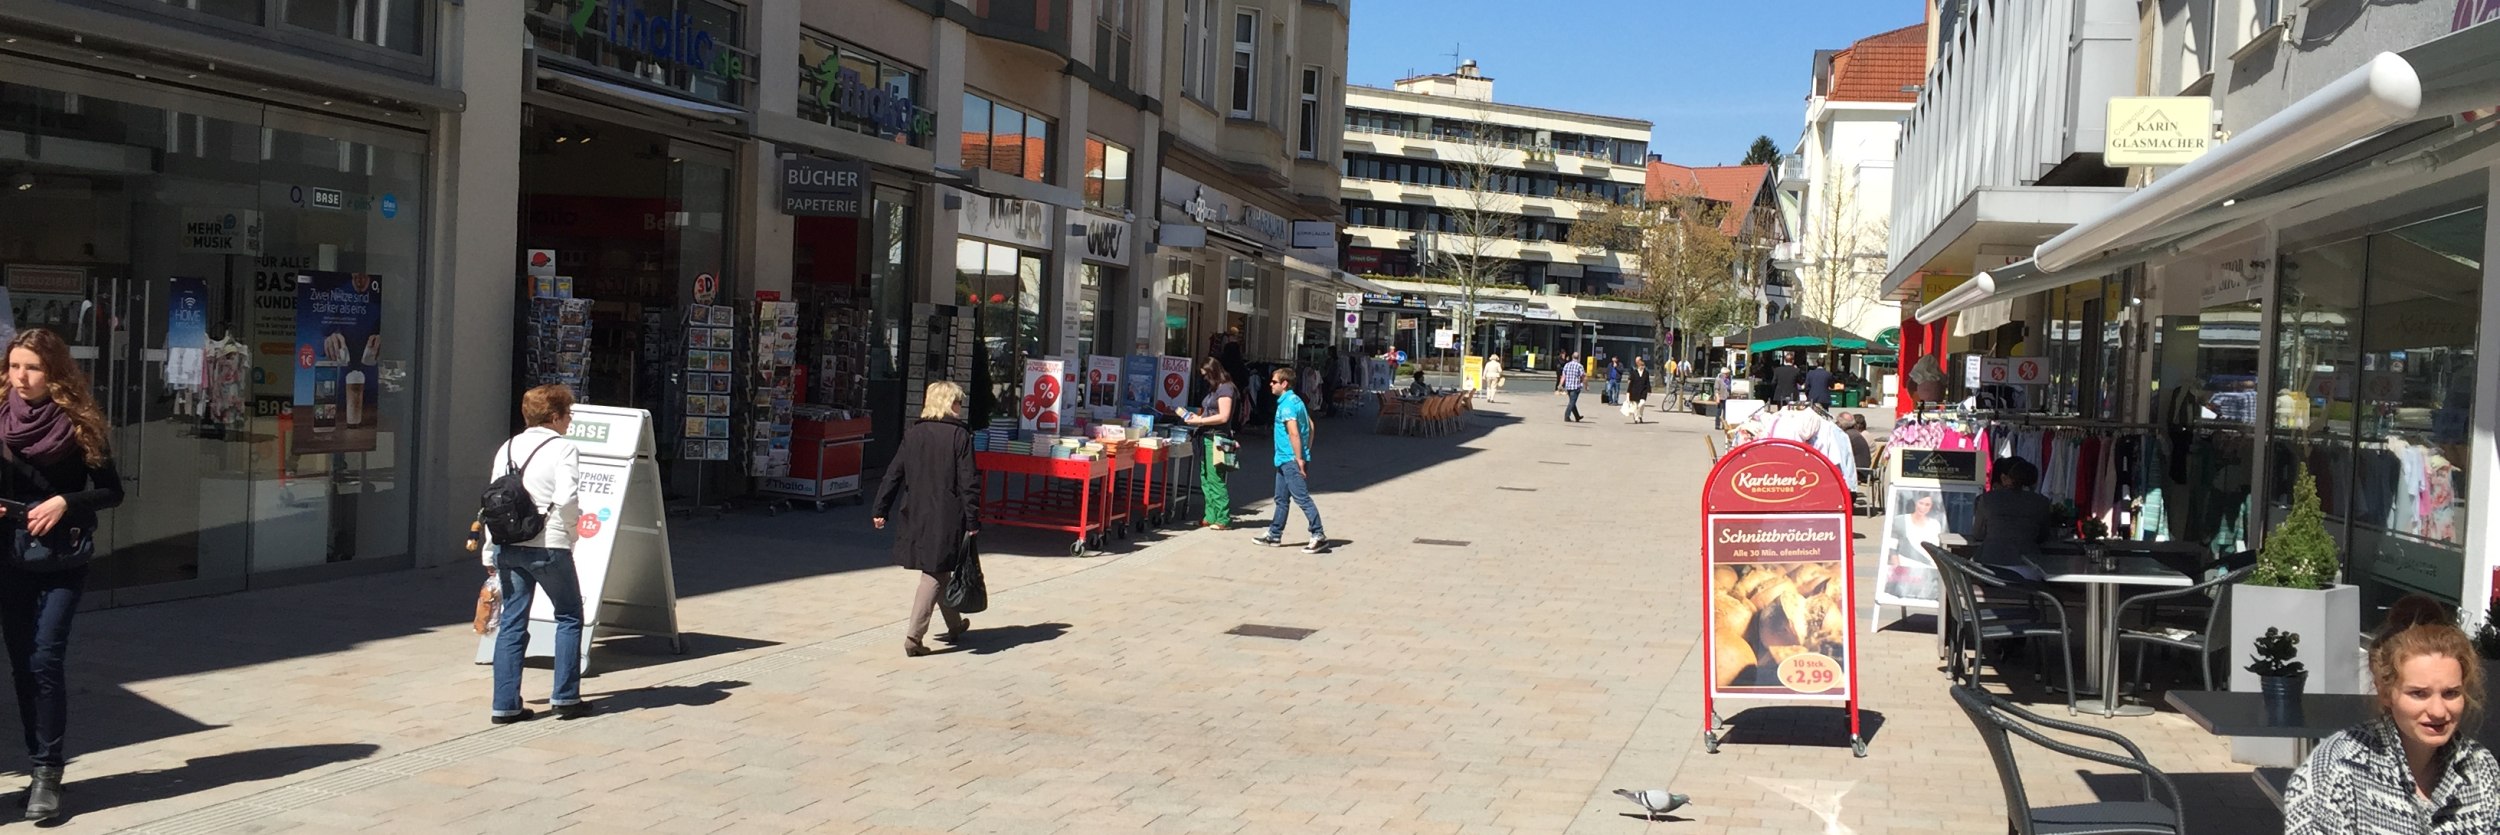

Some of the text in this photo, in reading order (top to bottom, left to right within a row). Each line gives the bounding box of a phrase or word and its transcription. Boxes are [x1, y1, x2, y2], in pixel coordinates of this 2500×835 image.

[2113, 104, 2150, 136] Collection
[2136, 121, 2179, 132] KARIN
[2112, 138, 2205, 148] GLASMACHER
[788, 165, 858, 187] BÜCHER
[315, 191, 340, 205] BASE
[786, 197, 857, 213] PAPETERIE
[187, 222, 223, 235] MEHR
[193, 236, 233, 249] MUSIK
[255, 255, 310, 269] FÜR ALLE
[256, 271, 297, 292] BAS
[697, 276, 713, 293] 3D
[255, 295, 298, 309] KUNDE
[310, 287, 370, 303] Zwei Netze sind
[175, 309, 201, 322] HOME
[340, 303, 351, 314] als
[351, 304, 368, 315] eins
[258, 400, 293, 415] BAS
[566, 423, 607, 439] BASE
[580, 471, 617, 483] TPHONE.
[1738, 472, 1807, 488] Karlchen's
[579, 481, 614, 495] ETZE.
[1719, 527, 1836, 544] Schnittbrötchen
[1733, 547, 1821, 557] Alle 30 Min. ofenfrisch!
[1793, 659, 1805, 668] 10
[1795, 669, 1833, 685] 2,99
